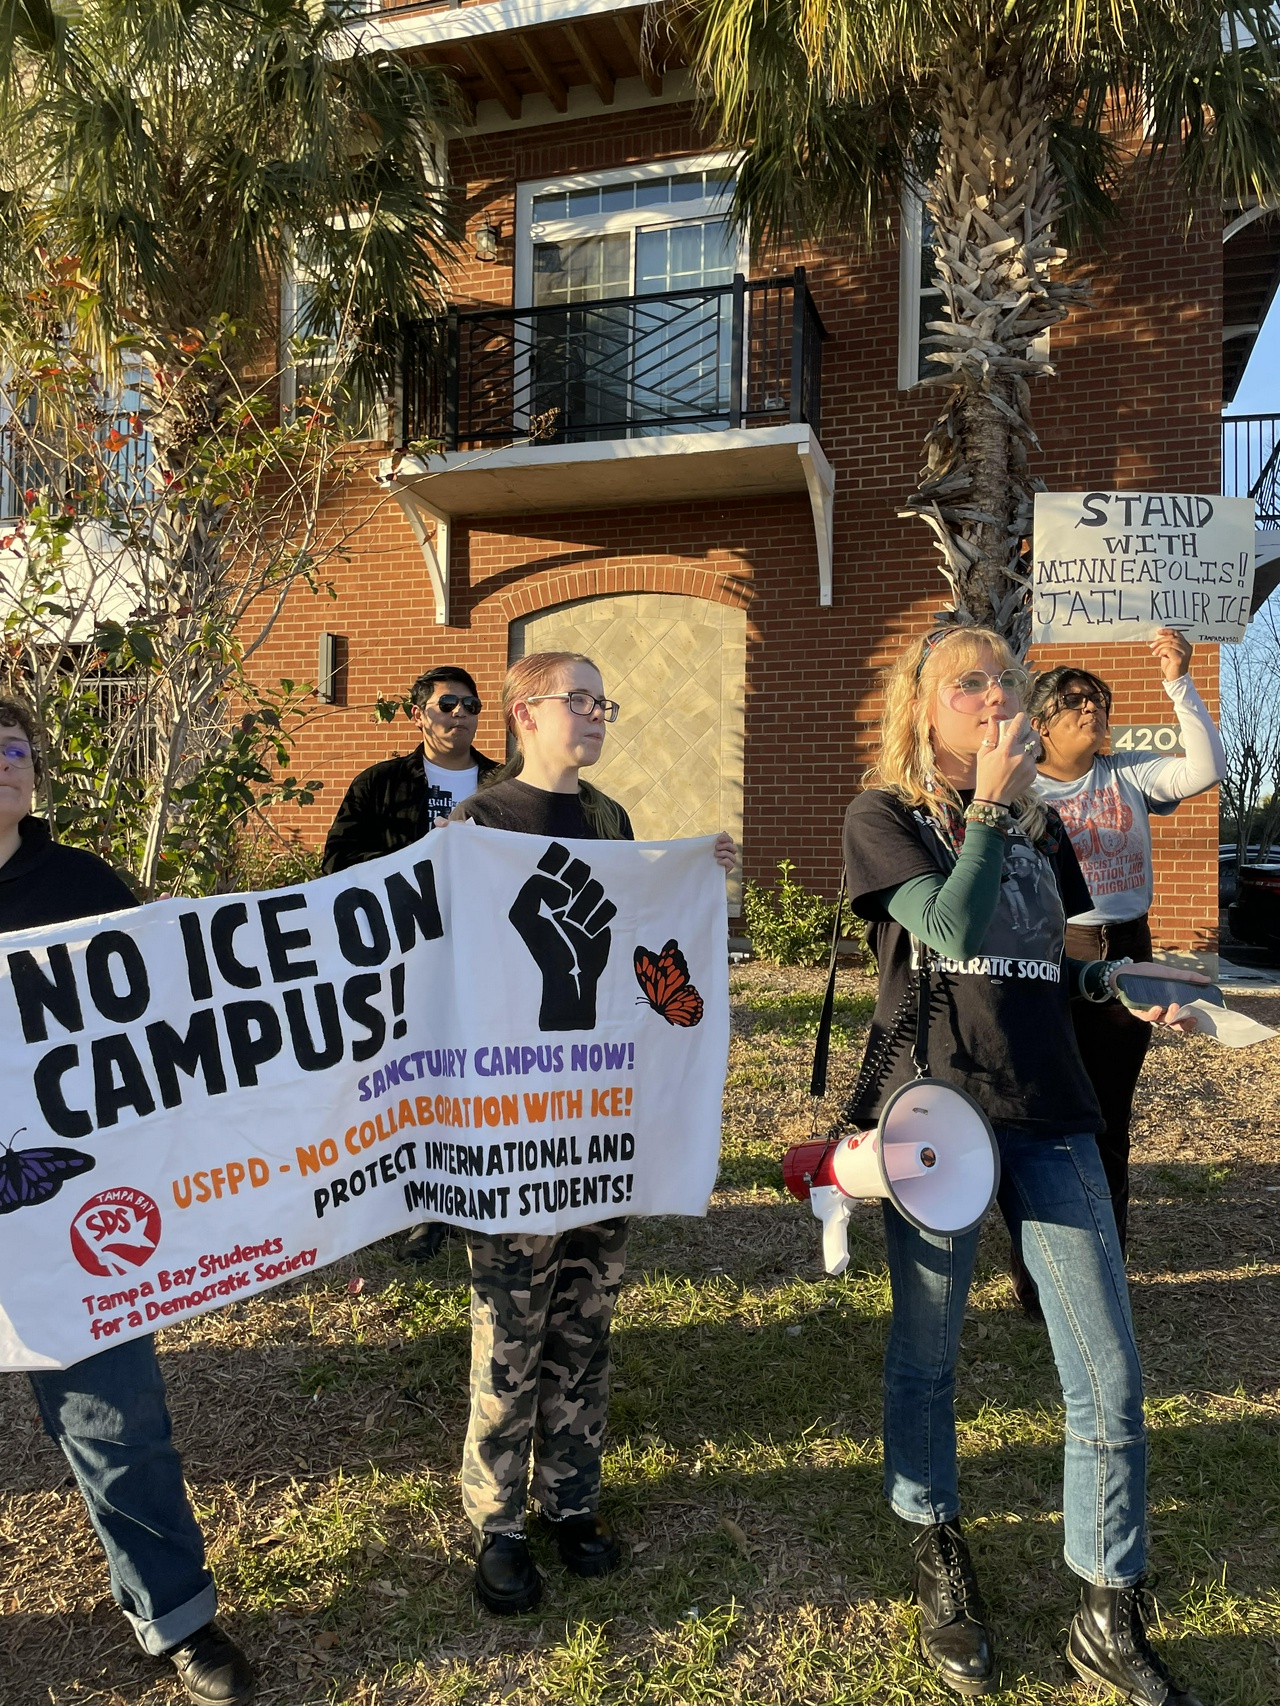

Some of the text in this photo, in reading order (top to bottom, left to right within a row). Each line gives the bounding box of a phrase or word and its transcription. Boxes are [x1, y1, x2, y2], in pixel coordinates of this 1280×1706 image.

[1074, 492, 1213, 529] STAND
[1103, 533, 1198, 557] WITH
[1036, 552, 1248, 588] MINNEAPOLIS!
[1036, 589, 1250, 627] JAIL KILLER ICE
[1115, 851, 1143, 866] ATTACKS
[1096, 874, 1146, 896] MIGRATION
[7, 859, 444, 1044] NO ICE ON
[1018, 960, 1061, 984] SOCIETY
[33, 962, 409, 1138] CAMPUS!
[358, 1042, 635, 1102] SANCTUARY CAMPUS NOW!
[172, 1157, 270, 1209] USFPD
[295, 1138, 339, 1176] NO
[344, 1094, 518, 1155] COLLABORATION
[523, 1090, 582, 1123] WITH
[590, 1087, 633, 1117] ICE!
[314, 1132, 635, 1219] PROTECT INTERNATIONAL AND
[96, 1190, 155, 1213] TAMPA BAY
[404, 1174, 633, 1220] IMMIGRANT STUDENTS!
[86, 1207, 131, 1242] SDS
[82, 1237, 284, 1316] Tampa Bay Students
[90, 1247, 318, 1340] for a Democratic Society
